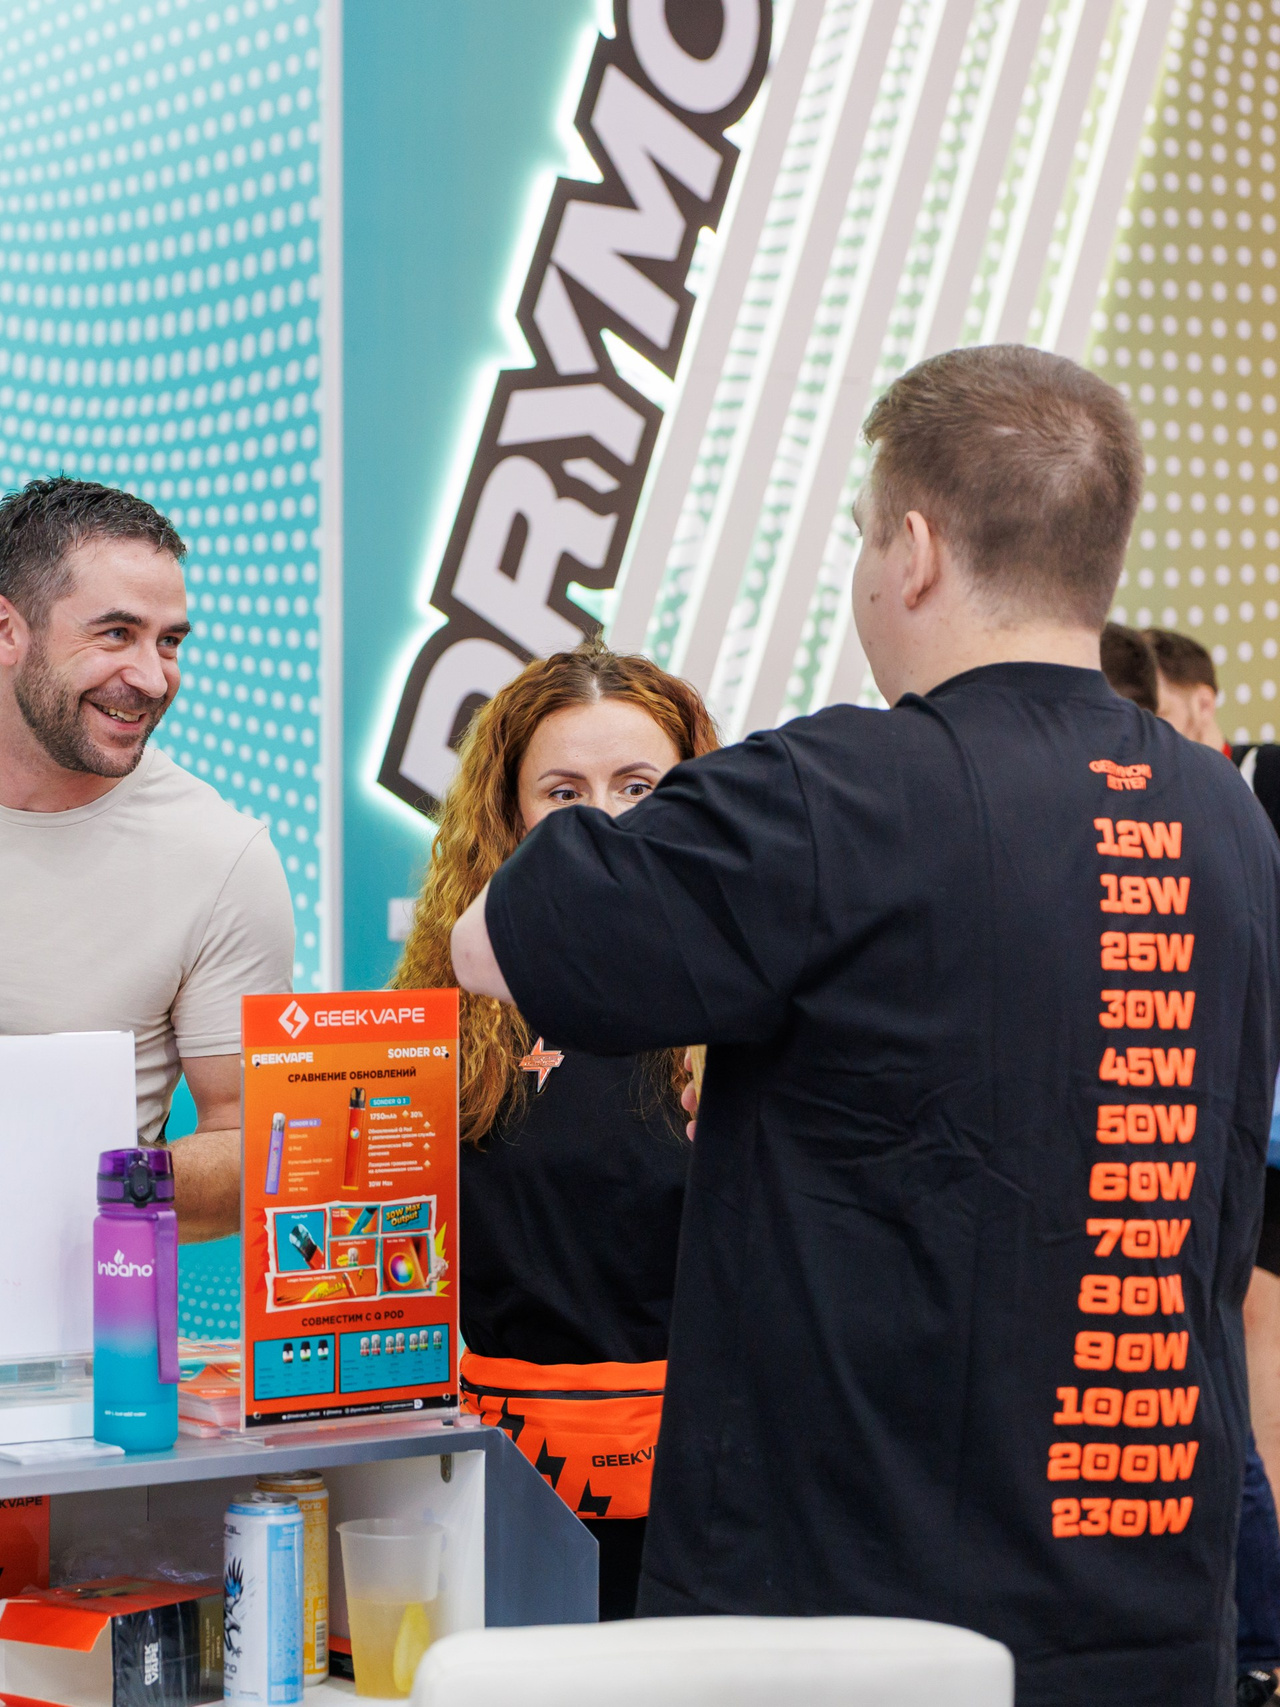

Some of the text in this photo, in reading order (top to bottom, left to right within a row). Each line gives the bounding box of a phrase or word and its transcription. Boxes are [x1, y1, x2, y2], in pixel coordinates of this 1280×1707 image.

[1093, 817, 1182, 859] 12W
[1100, 873, 1190, 915] 18W
[1100, 931, 1195, 972] 25W
[314, 1007, 425, 1027] GEEKVAPE
[1099, 989, 1196, 1030] 30W
[251, 1051, 314, 1067] GEEKVAPE
[388, 1046, 447, 1059] SONDER Q3
[1099, 1047, 1196, 1087] 45W
[287, 1066, 417, 1083] СРАВНЕНИЕ ОБНОВЛЕНИЙ
[1096, 1104, 1197, 1144] 50W
[1089, 1161, 1196, 1202] 60W
[1086, 1218, 1191, 1259] 70W
[1077, 1274, 1185, 1316] 80W
[301, 1313, 363, 1327] СОВМЕСТИМ
[374, 1312, 381, 1320] Q
[384, 1310, 404, 1320] POD
[1073, 1331, 1189, 1372] 90W
[1053, 1386, 1199, 1428] 100W
[592, 1444, 657, 1467] GEEKV
[1047, 1441, 1199, 1483] 200W
[1051, 1496, 1193, 1538] 230W
